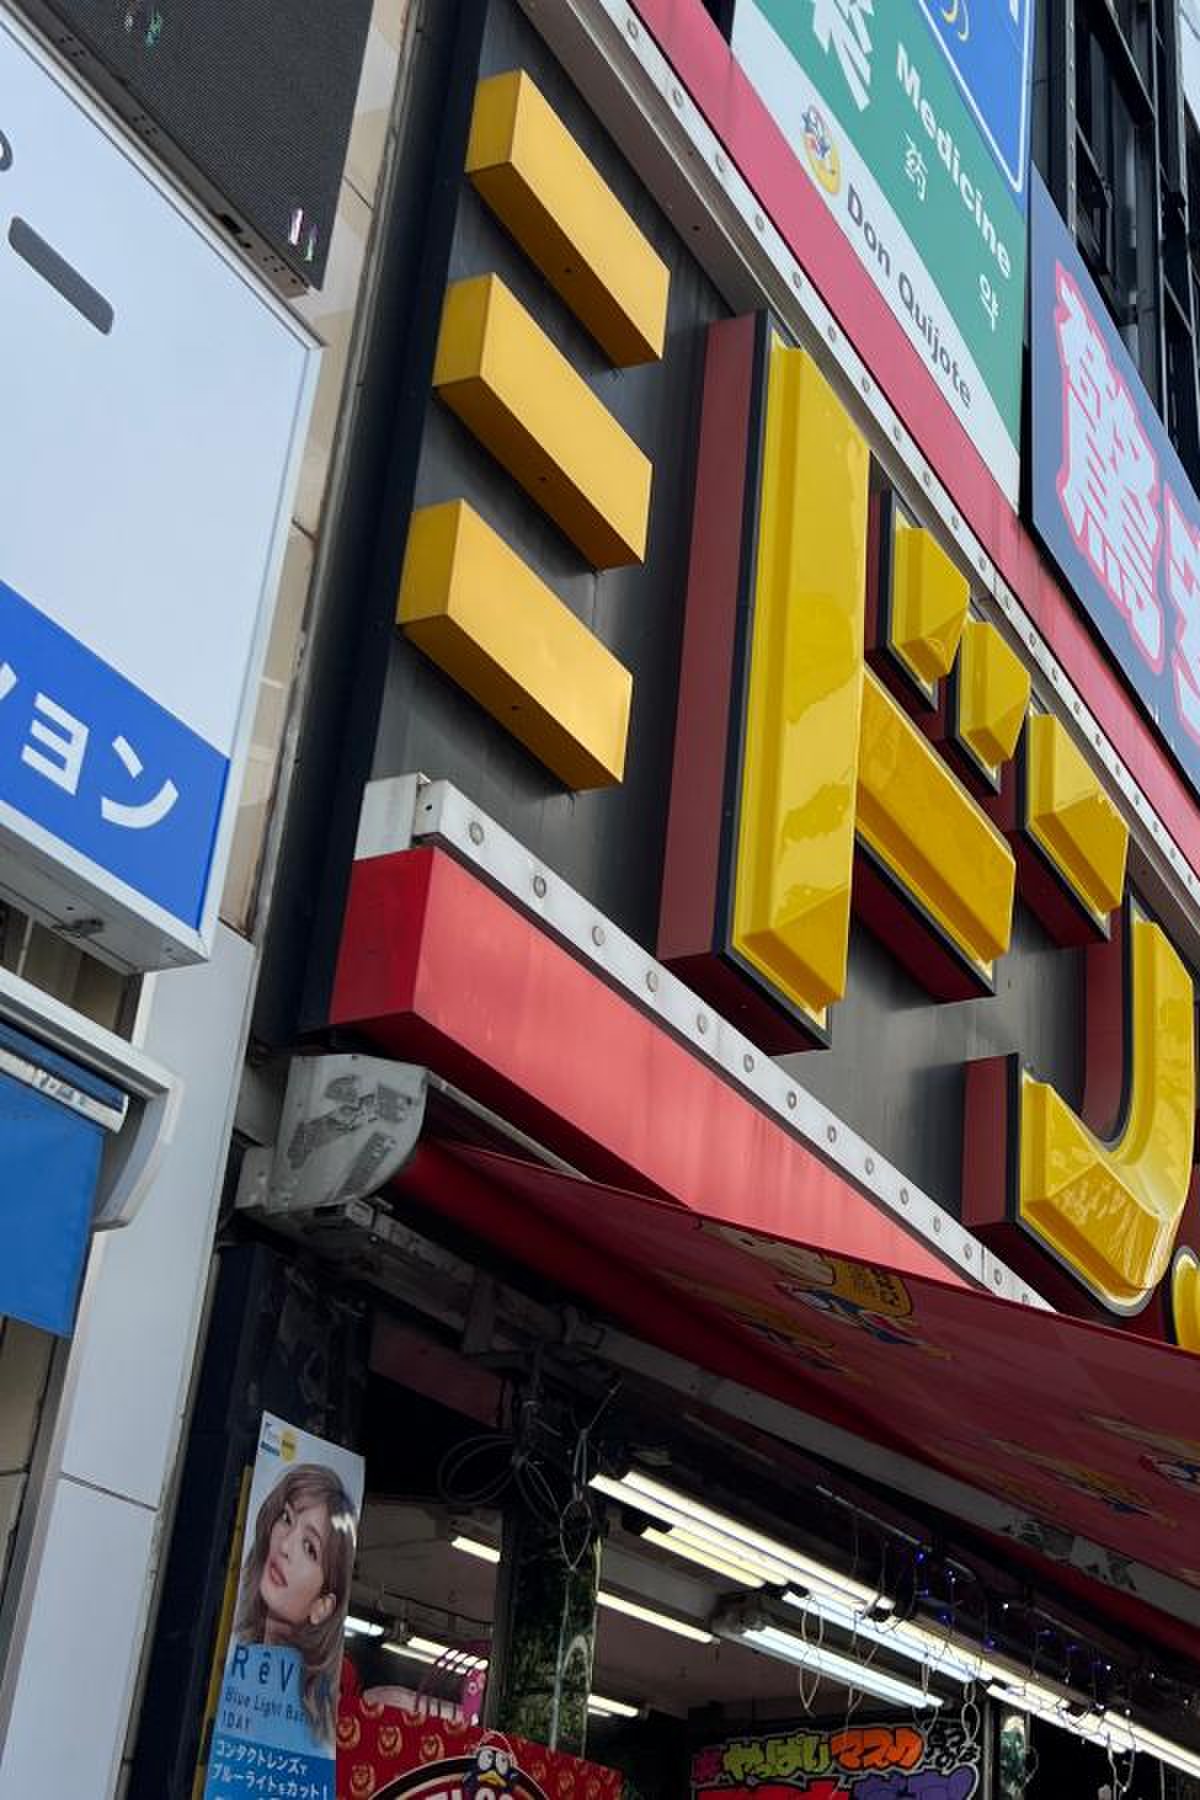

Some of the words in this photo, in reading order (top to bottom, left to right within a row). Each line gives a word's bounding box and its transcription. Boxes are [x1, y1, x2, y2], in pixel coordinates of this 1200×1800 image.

[897, 42, 1011, 279] Medicine
[848, 183, 891, 276] Don
[899, 273, 970, 408] Quijote
[0, 662, 179, 829] ョン
